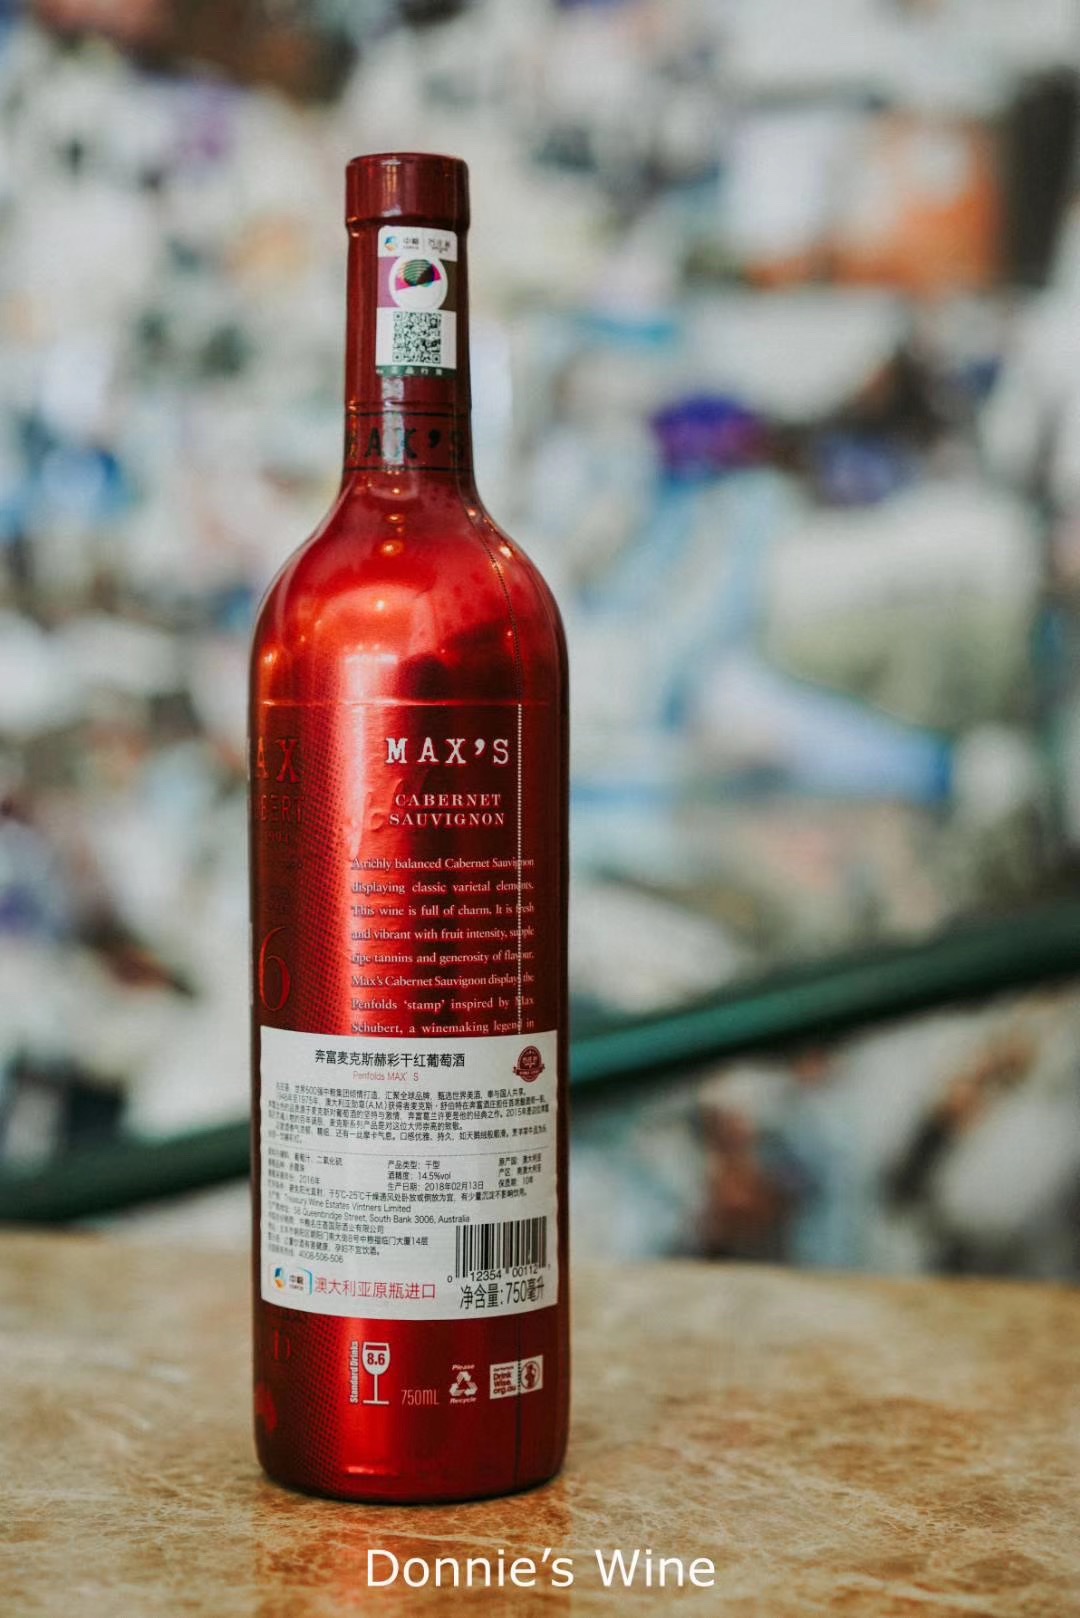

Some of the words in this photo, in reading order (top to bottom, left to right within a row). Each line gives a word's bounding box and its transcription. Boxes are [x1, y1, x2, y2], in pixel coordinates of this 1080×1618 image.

[385, 736, 509, 765] MAX'S
[395, 793, 501, 807] CABERNET
[389, 812, 505, 826] SAUVIGNON
[364, 857, 391, 872] richly
[395, 857, 442, 870] balanced
[444, 857, 490, 869] Cabernet
[352, 881, 406, 894] displaying
[412, 881, 446, 893] classic
[452, 881, 491, 892] varietal
[351, 905, 375, 916] This
[379, 905, 404, 916] wine
[408, 905, 417, 916] is
[421, 904, 439, 916] full
[443, 904, 455, 915] of
[457, 905, 493, 915] charm.
[495, 904, 503, 915] It
[505, 904, 513, 914] is
[352, 928, 371, 940] and
[373, 928, 410, 940] vibrant
[414, 928, 438, 939] with
[441, 928, 464, 939] fruit
[466, 927, 508, 942] intensity,
[352, 953, 371, 967] ripe
[374, 953, 413, 964] tannins
[416, 952, 436, 964] and
[439, 952, 489, 966] generosity
[492, 950, 503, 961] of
[352, 976, 383, 987] Max's
[385, 975, 433, 987] Cabernet
[434, 975, 487, 989] Sauvignon
[523, 972, 535, 983] the
[352, 997, 398, 1011] Penfolds
[451, 998, 493, 1011] inspired
[498, 996, 510, 1009] by
[352, 1021, 403, 1035] Schubert,
[408, 1025, 416, 1034] a
[422, 1021, 489, 1034] winemaking
[526, 1018, 535, 1028] in
[315, 1049, 466, 1068] 奔富麦克斯赫彩干红葡萄酒
[353, 1070, 385, 1081] Penfolds
[352, 1202, 382, 1212] Vintners
[383, 1203, 412, 1213] Limited
[369, 1213, 391, 1223] South
[393, 1214, 412, 1224] Bank
[414, 1215, 436, 1225] 3006,
[438, 1215, 470, 1224] Australia
[470, 1269, 502, 1282] 12354
[315, 1276, 436, 1300] 澳大利亚原瓶进口
[367, 1353, 386, 1366] 8.6
[350, 1366, 359, 1404] Standard
